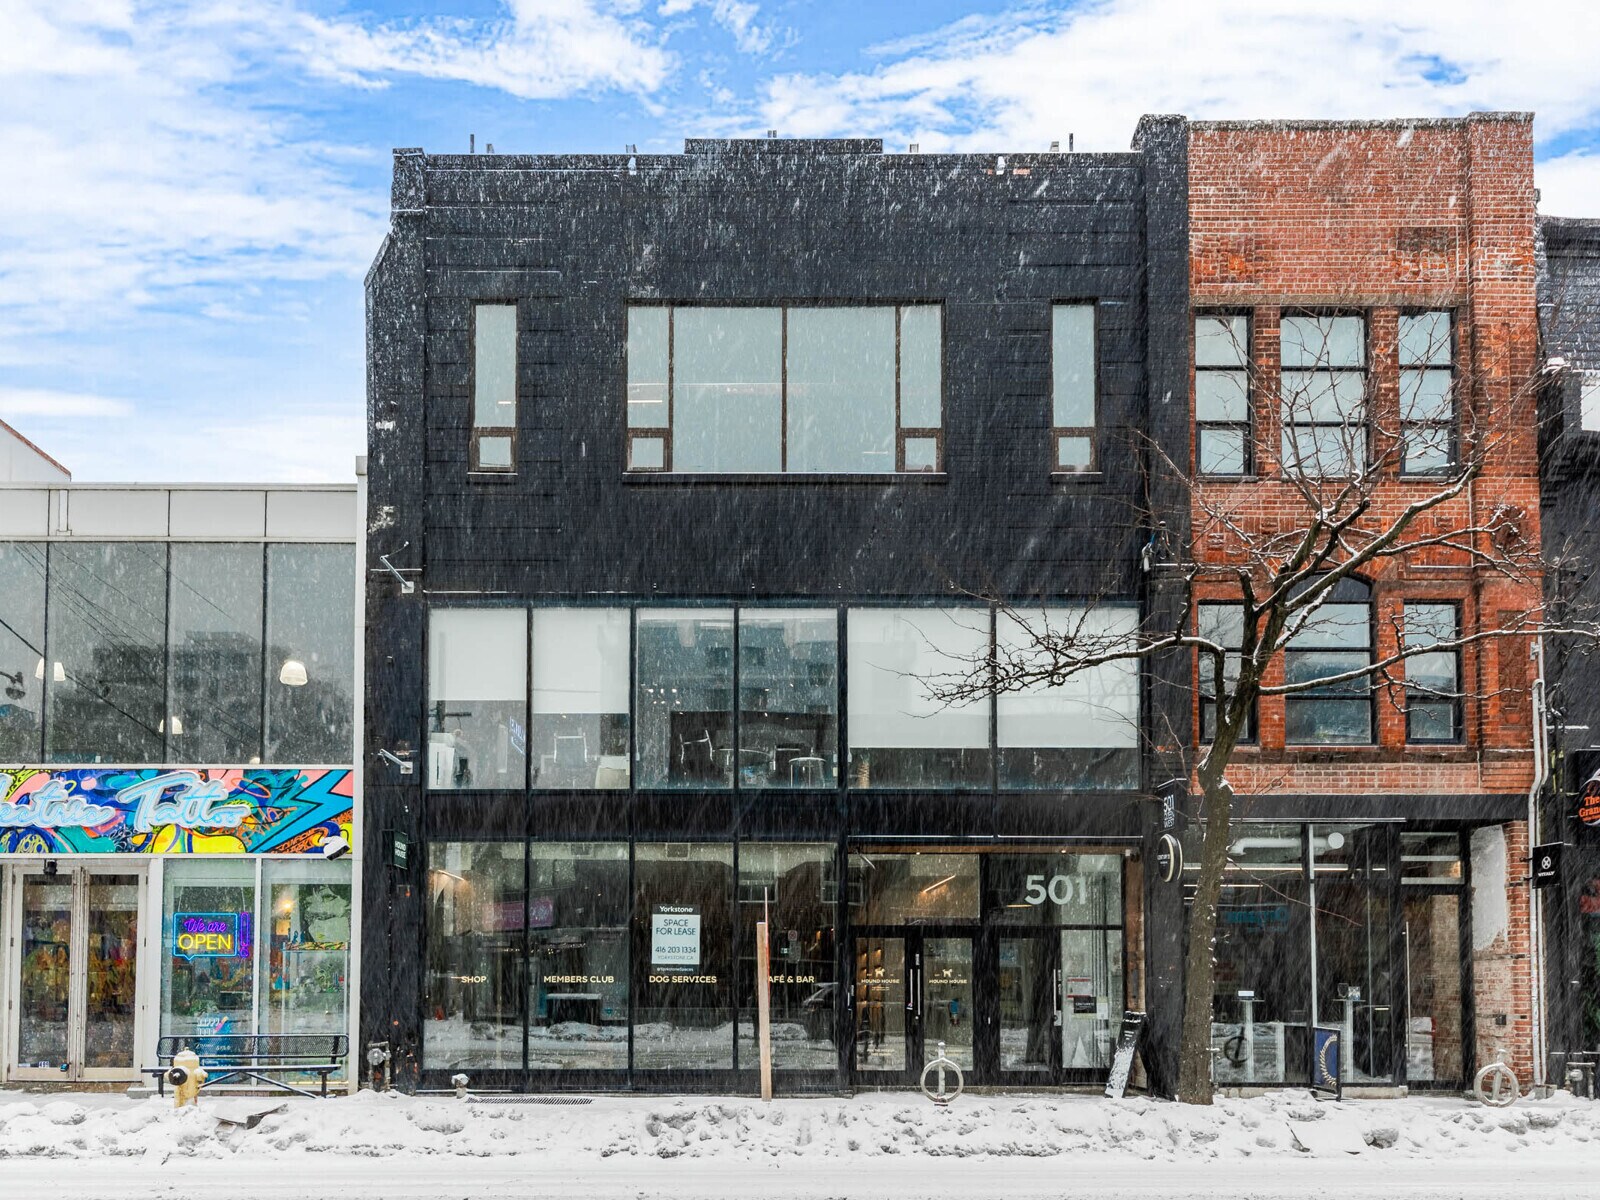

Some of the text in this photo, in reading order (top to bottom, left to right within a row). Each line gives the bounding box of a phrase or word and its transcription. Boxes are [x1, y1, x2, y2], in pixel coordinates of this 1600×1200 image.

[115, 770, 251, 832] Tattoo
[1163, 794, 1175, 813] 501
[1578, 806, 1600, 818] Gran
[394, 840, 407, 852] HOUND
[394, 848, 406, 860] HOUSE
[1025, 874, 1087, 905] 501
[659, 905, 694, 913] Yorkstone
[183, 917, 227, 933] We are
[663, 918, 689, 927] SPACE
[656, 927, 696, 936] FOR LEASE
[178, 934, 232, 950] OPEN
[461, 975, 487, 983] SHOP
[543, 975, 615, 983] MEMBERS CLUB
[649, 975, 717, 983] DOG SERVICES
[768, 974, 815, 983] AFÉ & BAR
